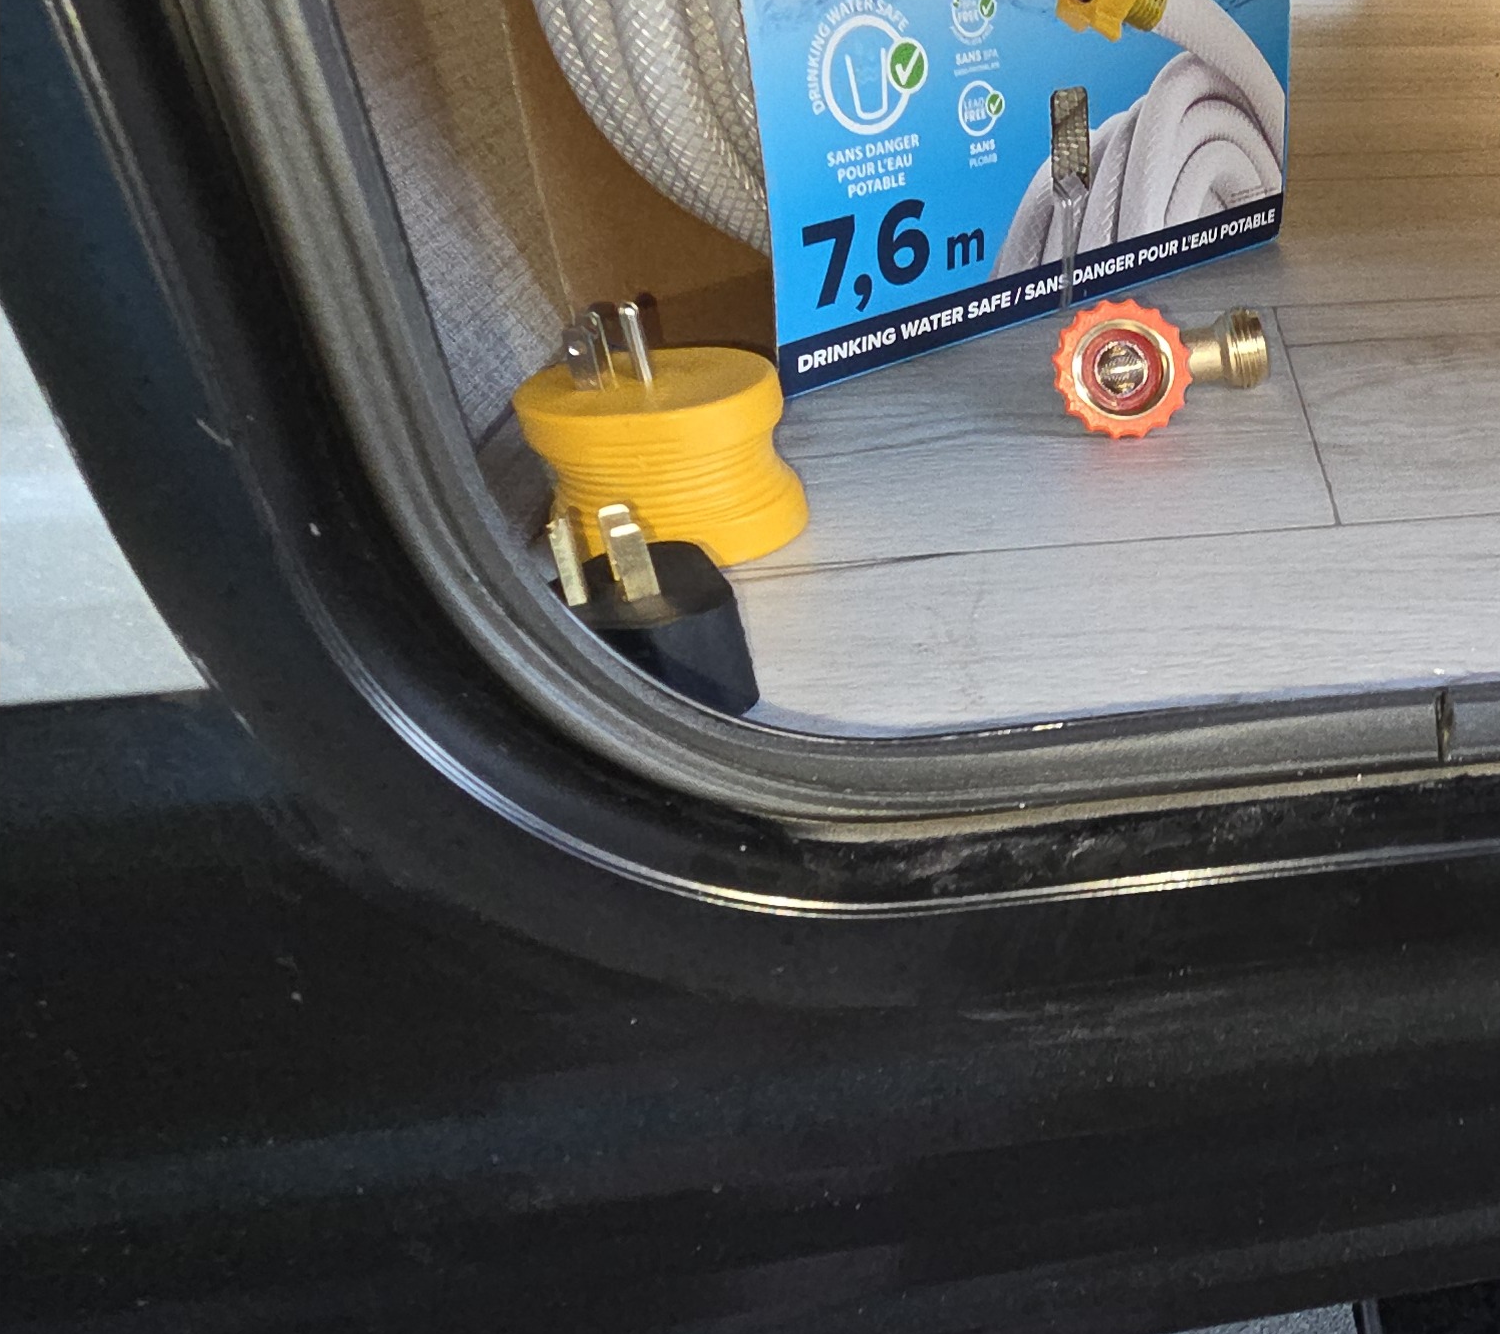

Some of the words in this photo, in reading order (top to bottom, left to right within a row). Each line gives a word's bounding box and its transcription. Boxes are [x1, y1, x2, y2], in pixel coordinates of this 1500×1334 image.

[806, 22, 831, 116] DRINKING
[956, 49, 981, 66] SANS
[827, 145, 864, 168] SANS
[865, 133, 920, 159] DANGER
[970, 138, 996, 156] SANS
[837, 161, 875, 184] POUR
[877, 153, 913, 175] L'EAU
[848, 172, 906, 199] POTABLE
[802, 198, 930, 312] 7,6
[947, 228, 985, 271] m
[797, 327, 896, 374] DRINKING
[900, 306, 964, 341] WATER
[967, 290, 1012, 319] SAFE
[1014, 287, 1022, 306] /
[1025, 273, 1072, 301] SANS
[1072, 252, 1135, 286] DANGER
[1138, 240, 1179, 266] POUR
[1181, 231, 1218, 252] L'EAU
[1220, 208, 1275, 240] POTABLE
